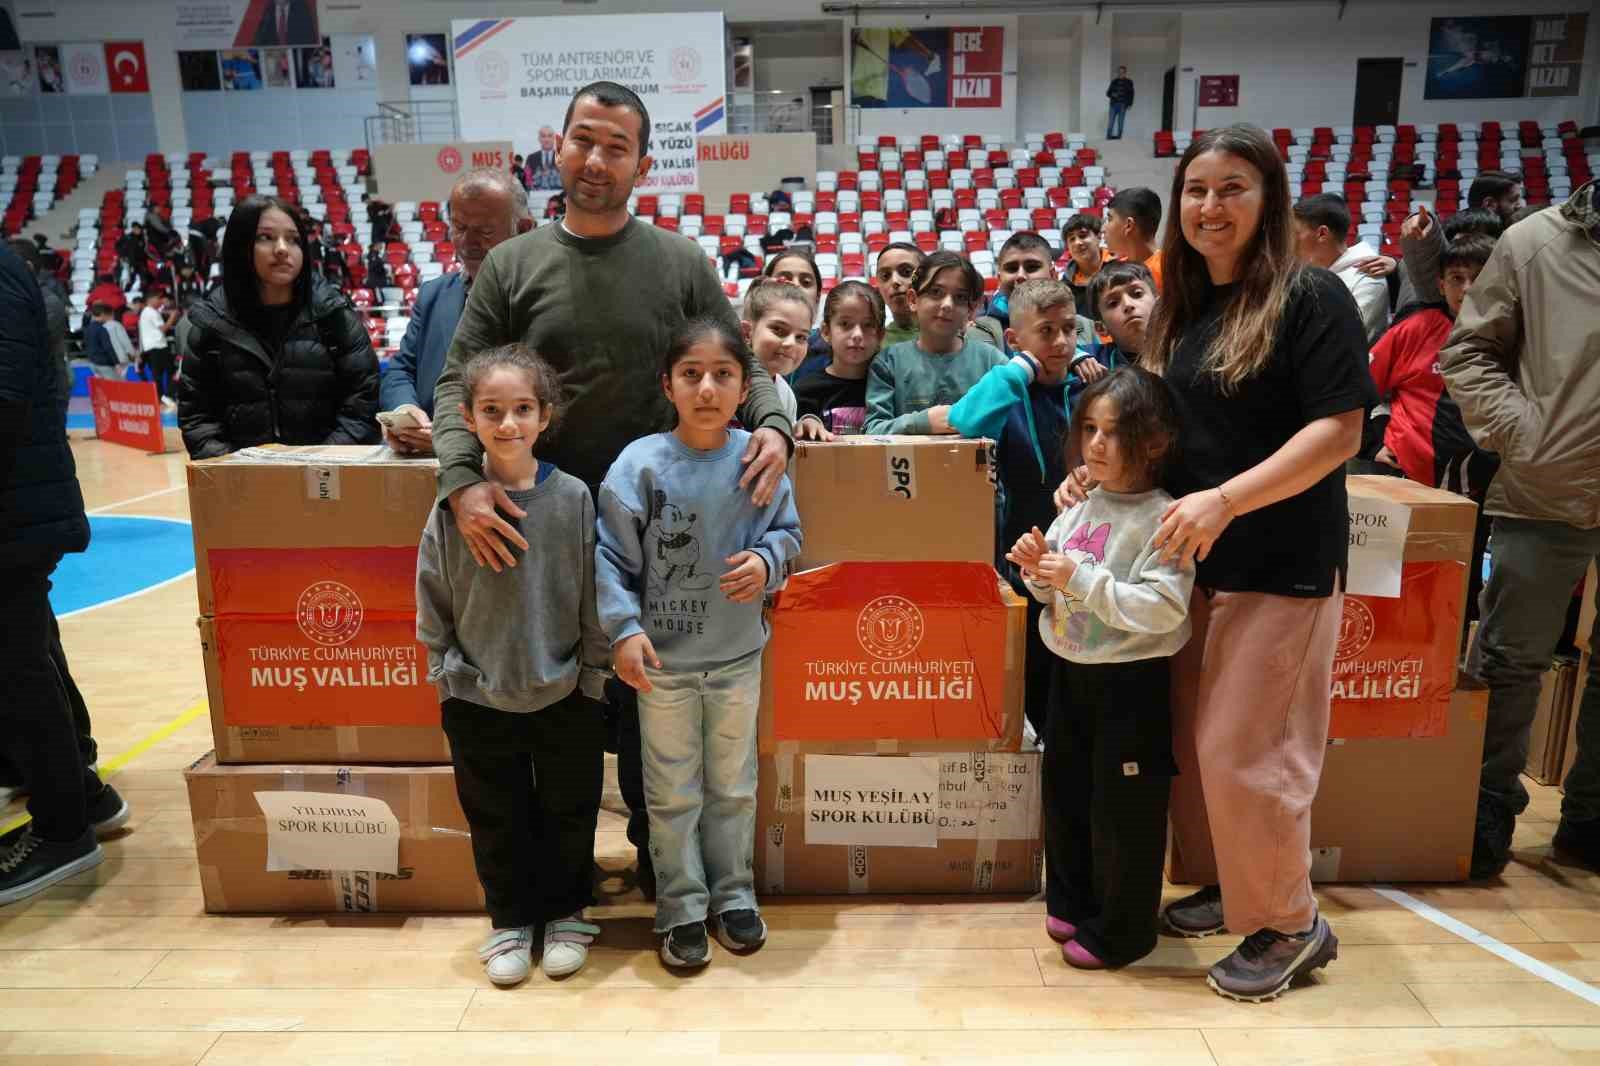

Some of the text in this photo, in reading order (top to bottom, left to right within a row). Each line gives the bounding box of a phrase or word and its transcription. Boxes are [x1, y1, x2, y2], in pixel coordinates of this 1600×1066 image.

[520, 49, 655, 67] TÜM ANTRENÖR VE
[527, 66, 651, 82] SPORCULARIMIZA
[520, 85, 578, 98] BAŞARILA
[660, 136, 693, 150] YÜZÜ
[697, 141, 750, 161] RLÜĞÜ
[662, 156, 694, 168] VALİSİ
[1348, 512, 1388, 527] SPOR
[649, 599, 708, 613] MICKEY
[653, 619, 704, 635] MOUSE
[249, 645, 416, 661] TÜRKİYE CUMHURİYETİ
[805, 659, 975, 675] TÜRKİYE CUMHURİYETİ
[251, 662, 418, 691] MUŞ VALİLİĞİ
[805, 676, 973, 705] MUŞ VALİLİĞİ
[1330, 675, 1421, 699] ALİLİĞİ
[813, 789, 851, 805] MUŞ
[857, 787, 934, 806] YEŞİLAY
[291, 806, 369, 818] YILDIRIM
[810, 809, 936, 825] SPOR KULÜBÜ
[278, 819, 388, 835] SPOR KULÜBÜ
